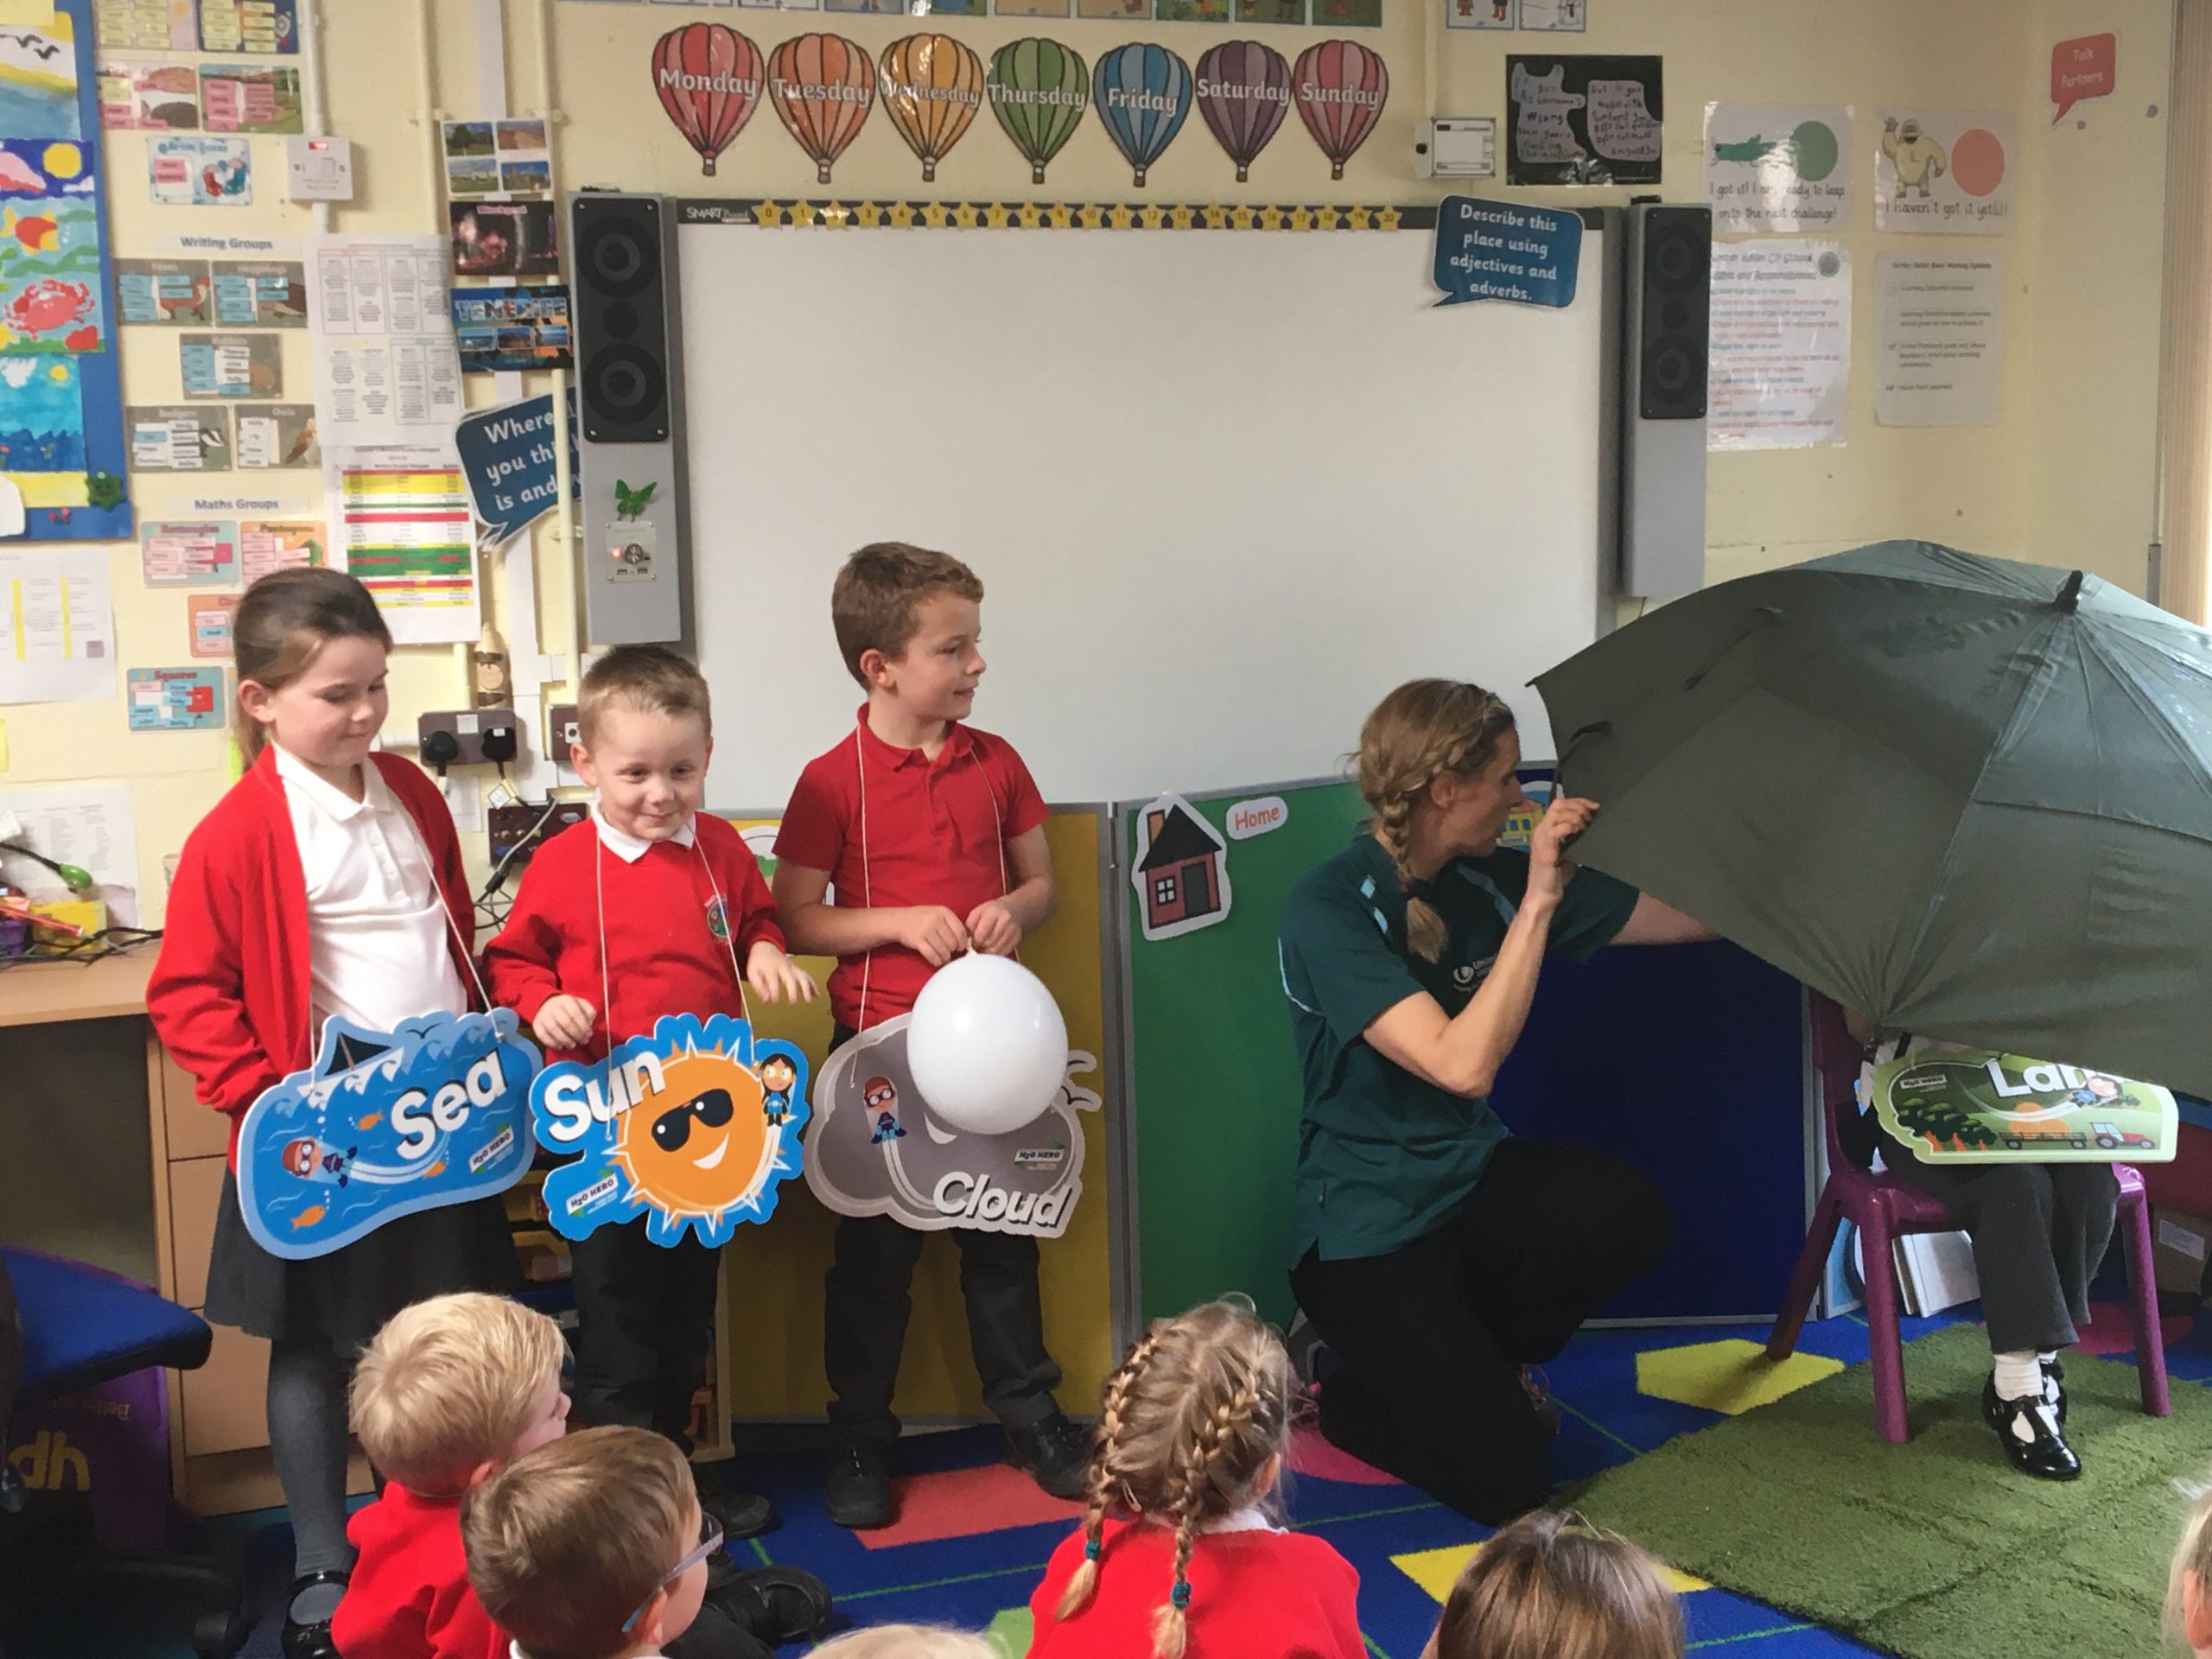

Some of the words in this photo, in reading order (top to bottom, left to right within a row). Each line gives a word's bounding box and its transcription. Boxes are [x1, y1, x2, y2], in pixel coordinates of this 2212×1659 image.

[659, 68, 758, 101] Monday
[773, 79, 870, 109] Tuesday
[880, 79, 980, 108] Wednesday
[1197, 79, 1290, 107] Saturday
[2061, 72, 2103, 88] Partners
[988, 84, 1088, 112] Thursday
[1108, 88, 1178, 118] Friday
[1300, 82, 1380, 111] Sunday
[1717, 183, 1733, 200] got
[1783, 184, 1810, 200] eady
[1813, 184, 1823, 194] to
[1826, 184, 1845, 200] leap
[686, 207, 722, 219] SMART
[1460, 204, 1524, 226] Describe
[1529, 215, 1558, 232] this
[1745, 206, 1762, 219] the
[1893, 198, 1939, 214] haven't
[1942, 202, 1960, 219] got
[1964, 203, 1974, 214] it
[180, 236, 226, 250] Writing
[229, 238, 273, 250] Groups
[1463, 230, 1503, 248] place
[1508, 238, 1548, 259] using
[1450, 253, 1523, 276] adjectives
[1529, 266, 1558, 280] and
[1469, 281, 1533, 301] adverbs.
[484, 411, 554, 443] Where
[486, 456, 526, 486] you
[194, 499, 232, 510] Maths
[235, 499, 279, 511] Groups
[495, 494, 514, 512] is
[520, 474, 557, 503] and
[1234, 805, 1281, 831] Home
[391, 1046, 508, 1160] Sea
[543, 1051, 666, 1141] Sun
[489, 1132, 511, 1151] HERO
[589, 1179, 614, 1198] HERO
[933, 1171, 1073, 1228] Cloud
